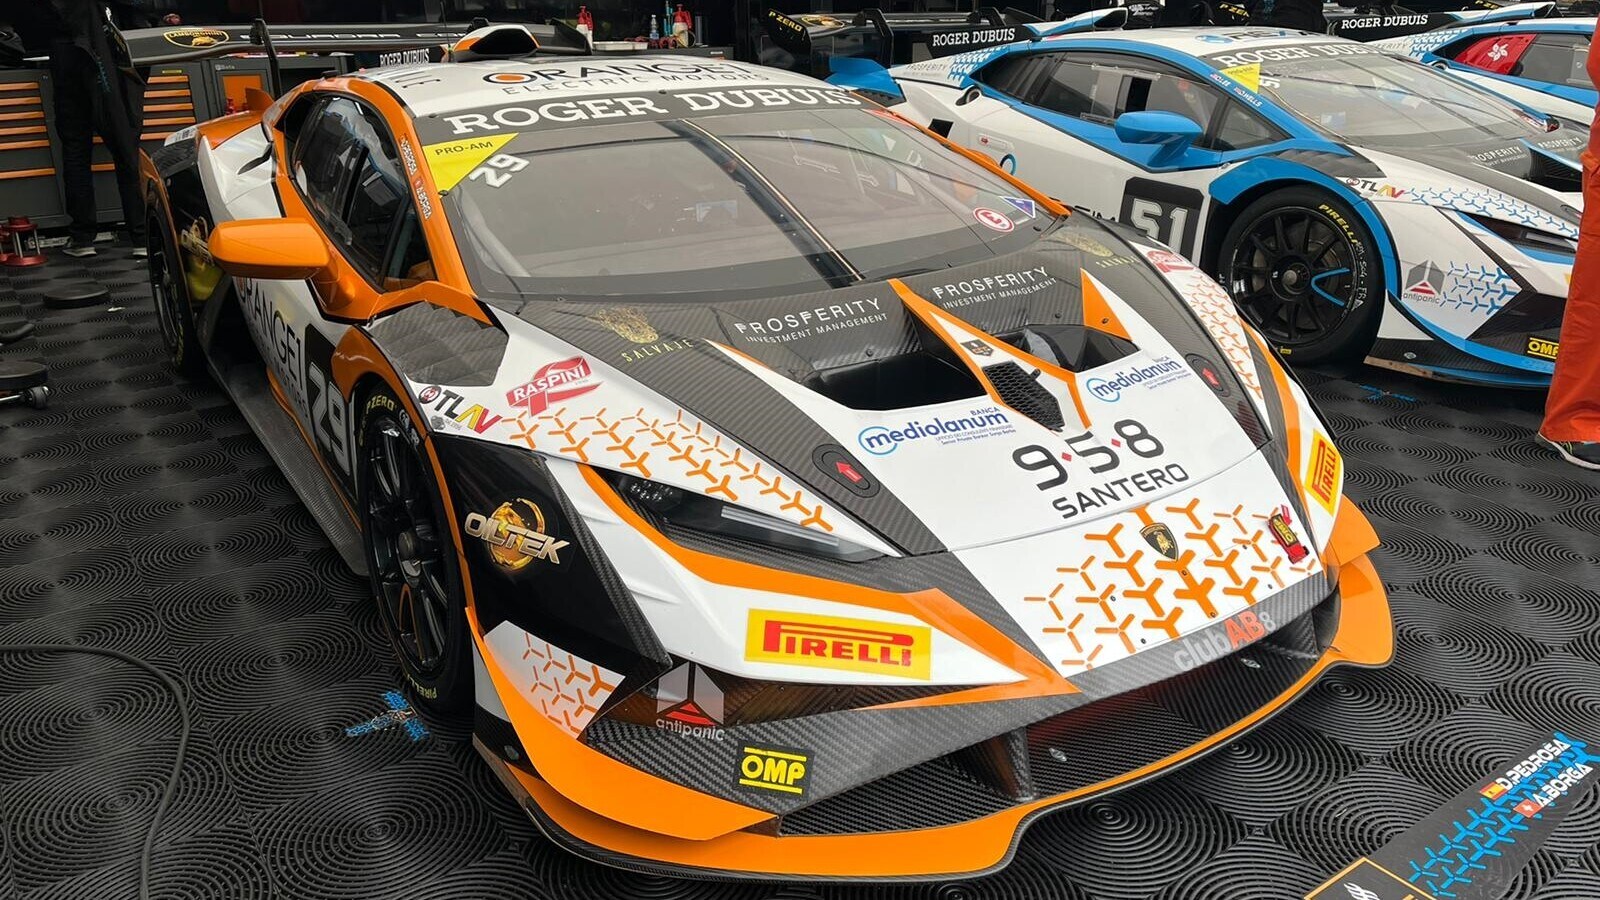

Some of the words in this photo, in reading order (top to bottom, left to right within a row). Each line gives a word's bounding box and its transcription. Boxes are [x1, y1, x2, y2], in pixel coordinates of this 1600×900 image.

[776, 14, 803, 32] ZERO
[932, 32, 971, 46] ROGER
[972, 28, 1016, 44] DUBUIS
[1341, 17, 1381, 29] ROGER
[1383, 14, 1428, 27] DUBUIS
[1212, 46, 1318, 67] ROGER
[502, 76, 648, 95] ELECTRIC
[443, 96, 669, 134] ROGER
[673, 86, 862, 111] DUBUIS
[435, 141, 493, 157] PRO-AM
[468, 154, 530, 188] 29
[1131, 198, 1188, 255] 51
[1319, 204, 1358, 243] PIRELLI
[931, 266, 1049, 300] PROSPERITY
[943, 291, 997, 310] INVESTMENT
[999, 277, 1058, 298] MANAGEMENT
[1403, 291, 1441, 305] antipanic
[733, 298, 882, 335] PROSPERITY
[745, 328, 812, 343] INVESTMENT
[815, 312, 889, 334] MANAGEMENT
[512, 364, 587, 402] RASPINI
[1093, 359, 1182, 397] mediolanum
[308, 361, 350, 473] 29
[371, 394, 395, 411] ZERO
[970, 406, 1001, 416] BANCA
[864, 412, 1009, 447] mediolanum
[1312, 439, 1336, 503] PIRELLI
[1052, 463, 1189, 519] SANTERO
[465, 512, 570, 564] OILTEK
[763, 620, 914, 667] PIRELLI
[656, 718, 726, 741] antipanic
[741, 755, 806, 786] OMP
[1496, 739, 1571, 790] D.PEDROSA
[1531, 763, 1594, 807] A.BORGA
